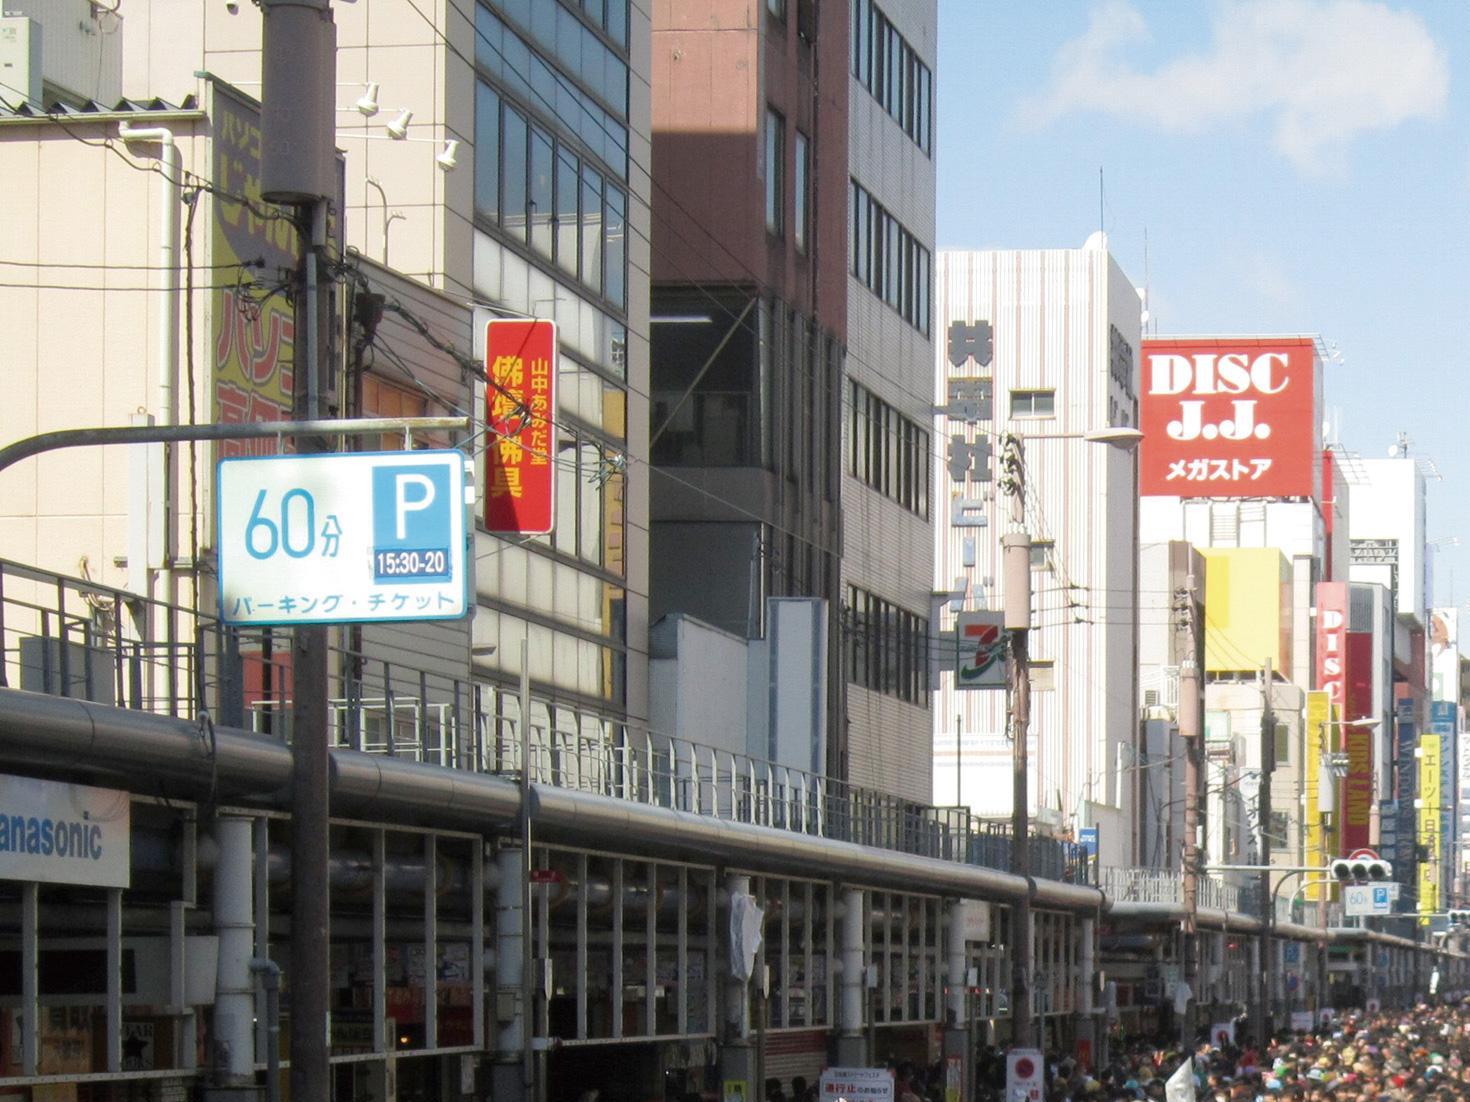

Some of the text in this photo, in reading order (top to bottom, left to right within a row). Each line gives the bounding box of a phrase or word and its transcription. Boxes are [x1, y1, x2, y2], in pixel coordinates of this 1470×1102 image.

[1148, 352, 1290, 395] DISC
[1166, 400, 1271, 441] J.J.
[1165, 457, 1273, 481] メガストア
[244, 487, 343, 561] 60分
[395, 474, 436, 540] P
[377, 552, 444, 574] 15:30-20
[1322, 609, 1343, 700] DISC
[1348, 779, 1369, 826] LAND
